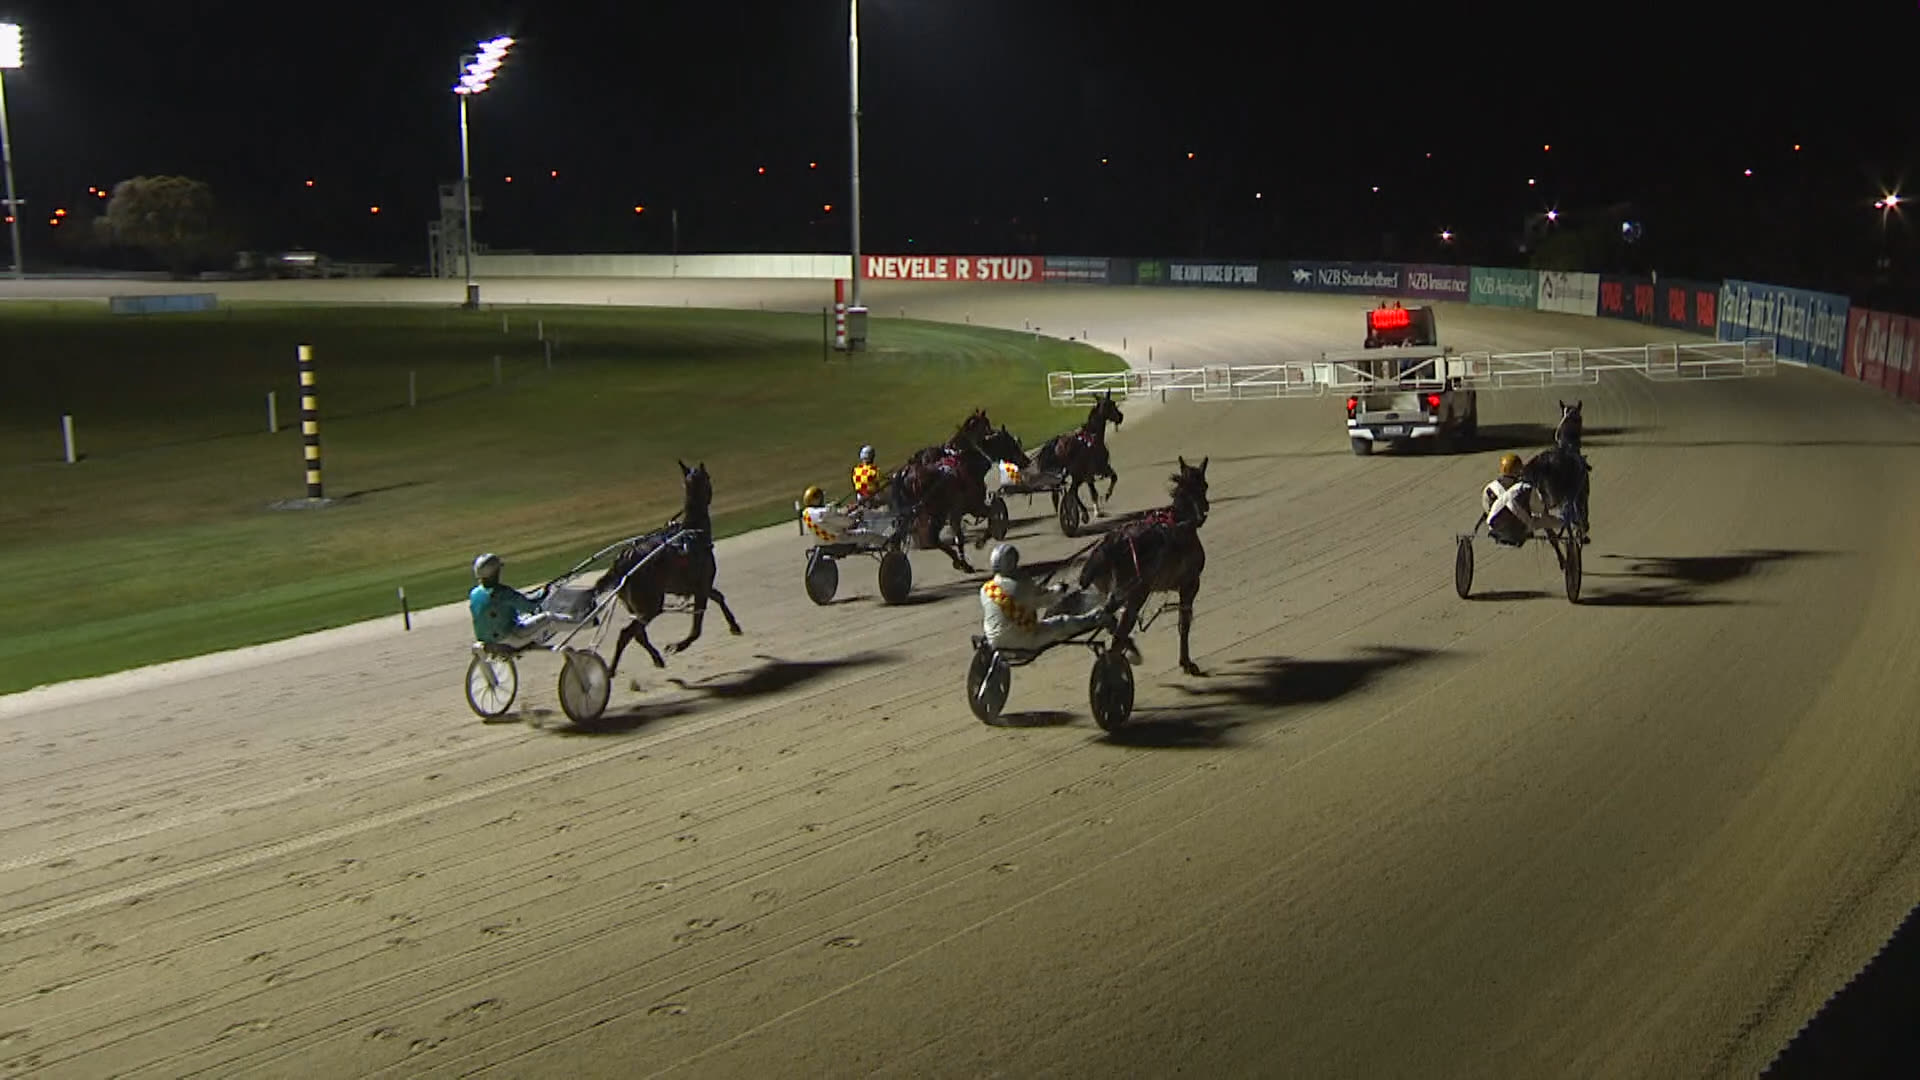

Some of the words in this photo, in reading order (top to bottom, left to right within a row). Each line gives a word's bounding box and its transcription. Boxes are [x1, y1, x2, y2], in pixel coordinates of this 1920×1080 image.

[868, 257, 948, 278] NEVELE
[956, 258, 970, 279] R
[977, 258, 1033, 280] STUD
[1170, 265, 1182, 281] THE
[1183, 265, 1200, 282] KIWI
[1201, 265, 1222, 282] VOICE
[1222, 265, 1232, 282] OF
[1233, 266, 1257, 283] SPORT
[1318, 269, 1340, 285] NZB
[1341, 269, 1398, 289] Standardbred
[1408, 272, 1428, 290] NZB
[1429, 273, 1467, 292] Insurance
[1475, 276, 1495, 294] NZB
